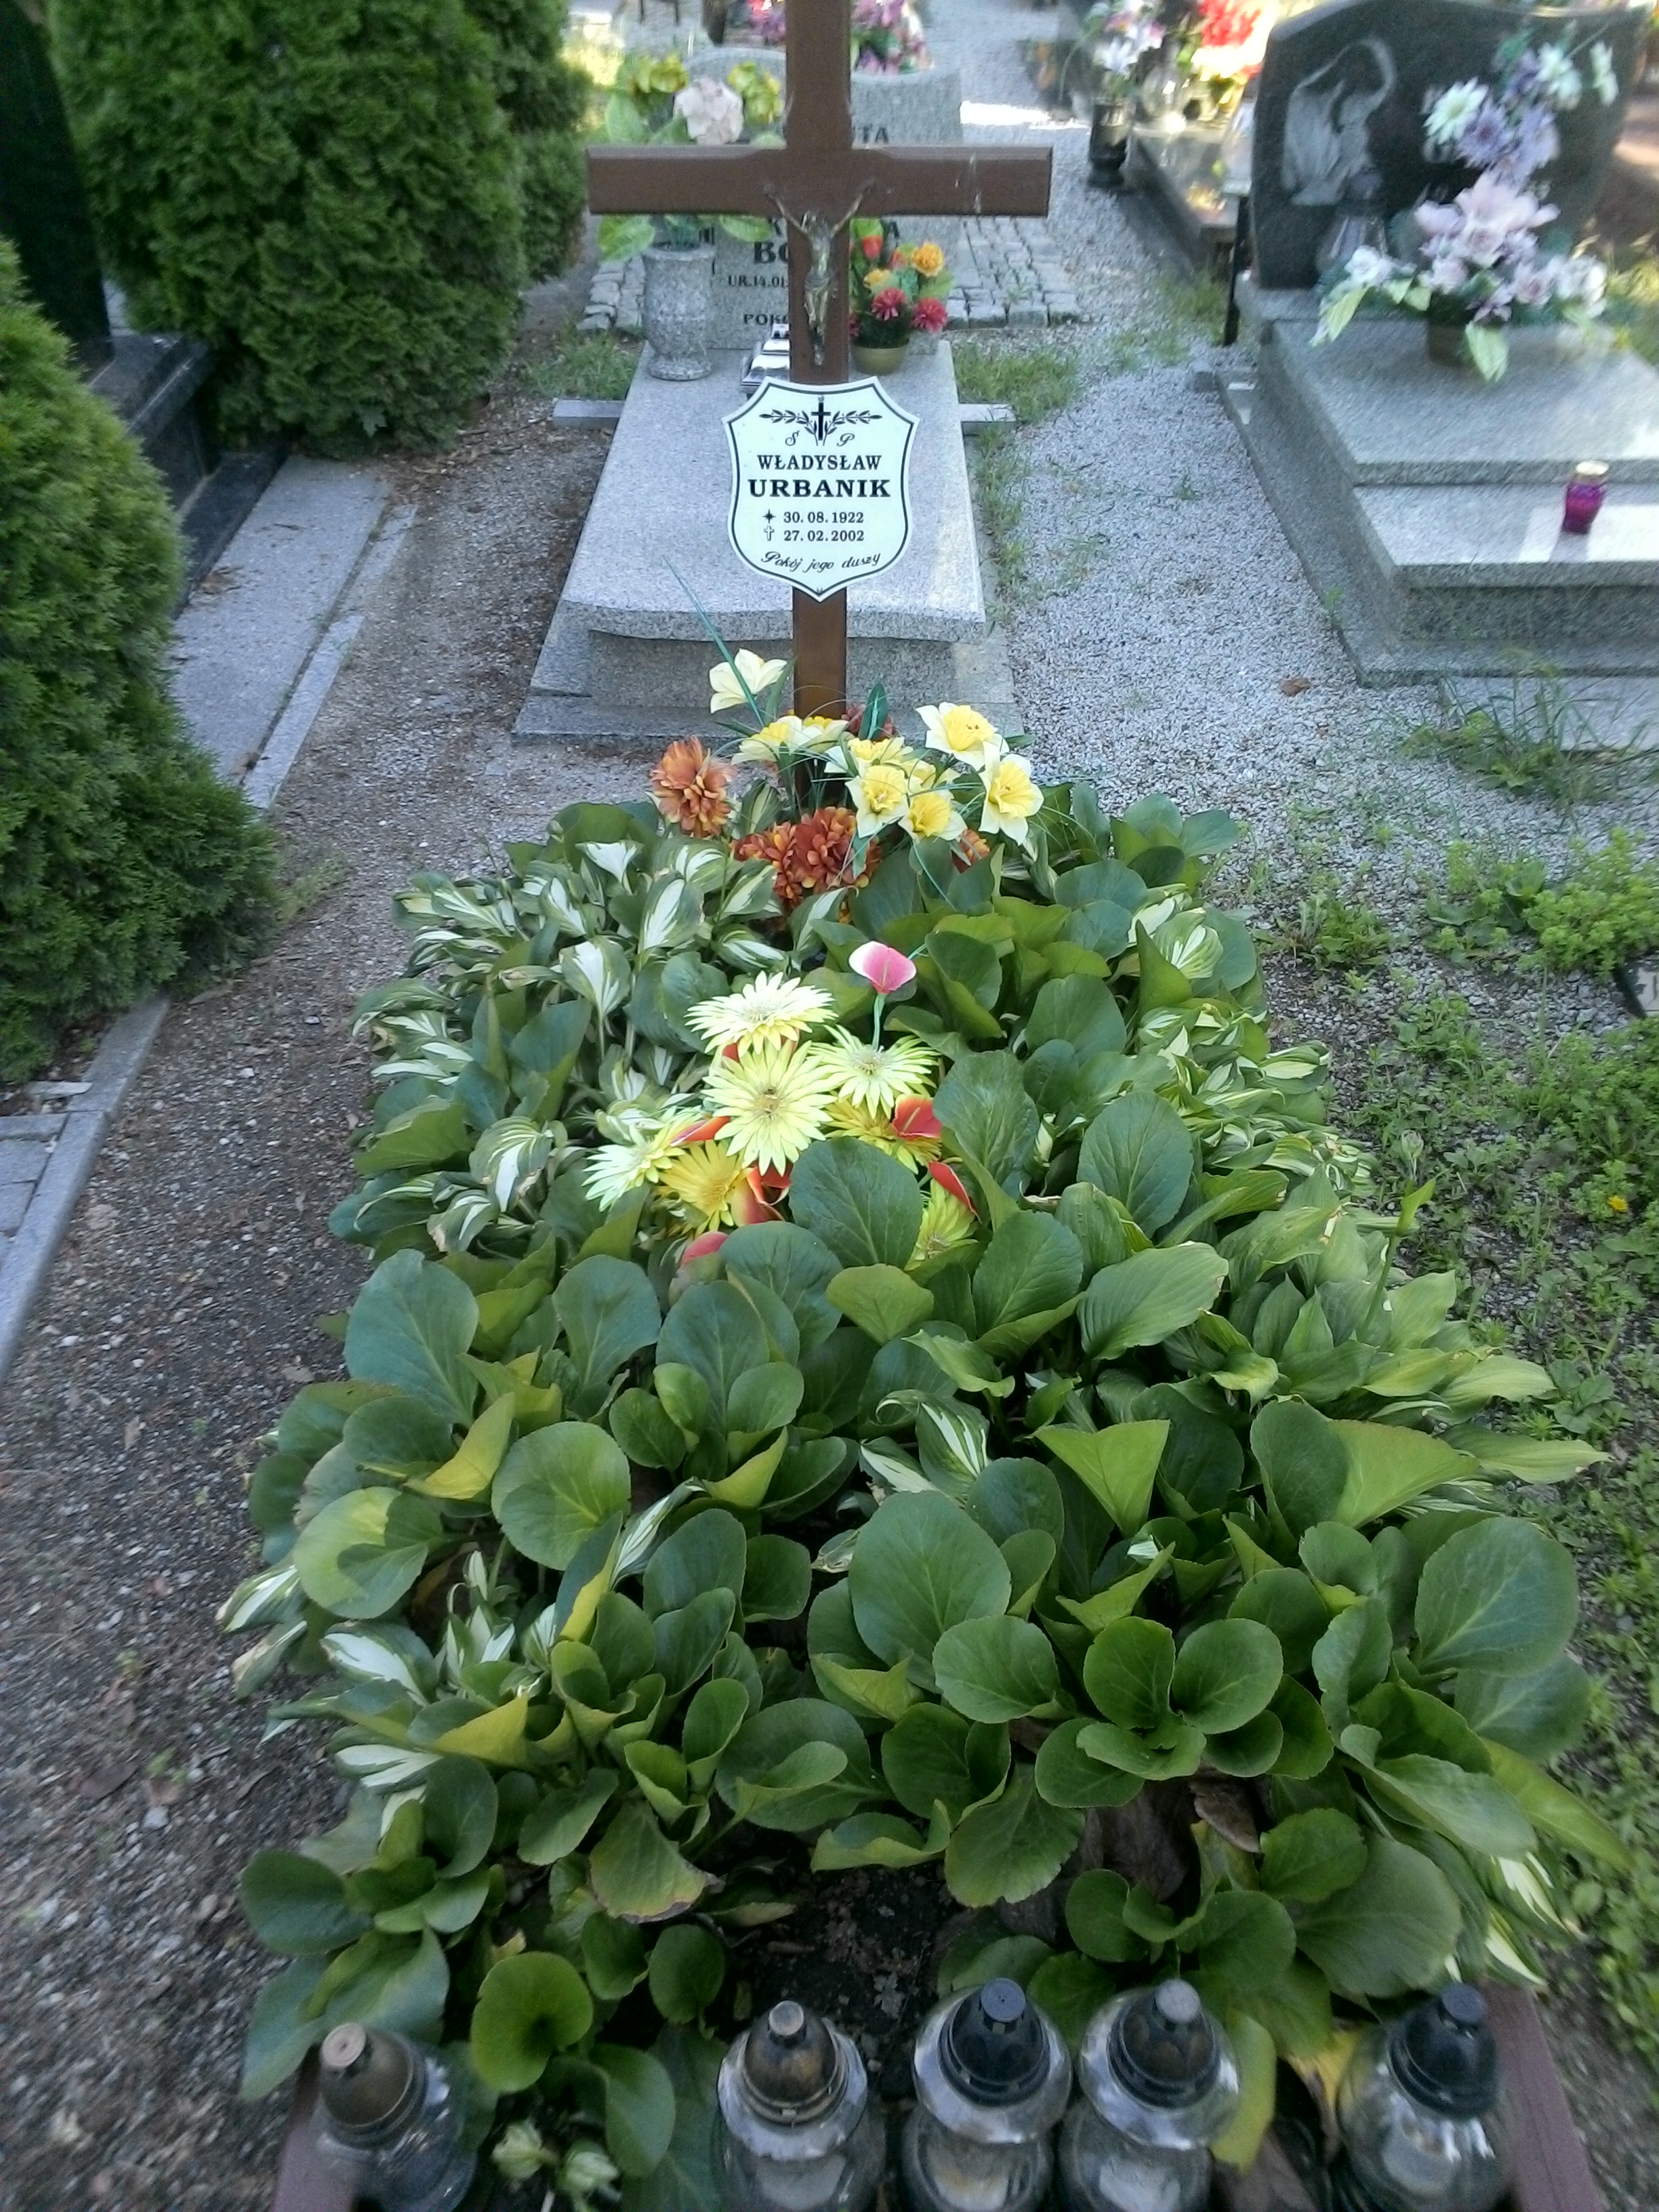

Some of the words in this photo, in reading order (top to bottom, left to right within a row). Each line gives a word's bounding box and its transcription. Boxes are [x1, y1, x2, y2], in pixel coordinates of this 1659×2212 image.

[836, 433, 855, 447] P
[757, 455, 882, 470] WŁADYSŁAW
[747, 479, 890, 497] URBANIK
[760, 551, 803, 572] Pokój
[802, 558, 834, 573] jego
[841, 553, 881, 567] duszy
